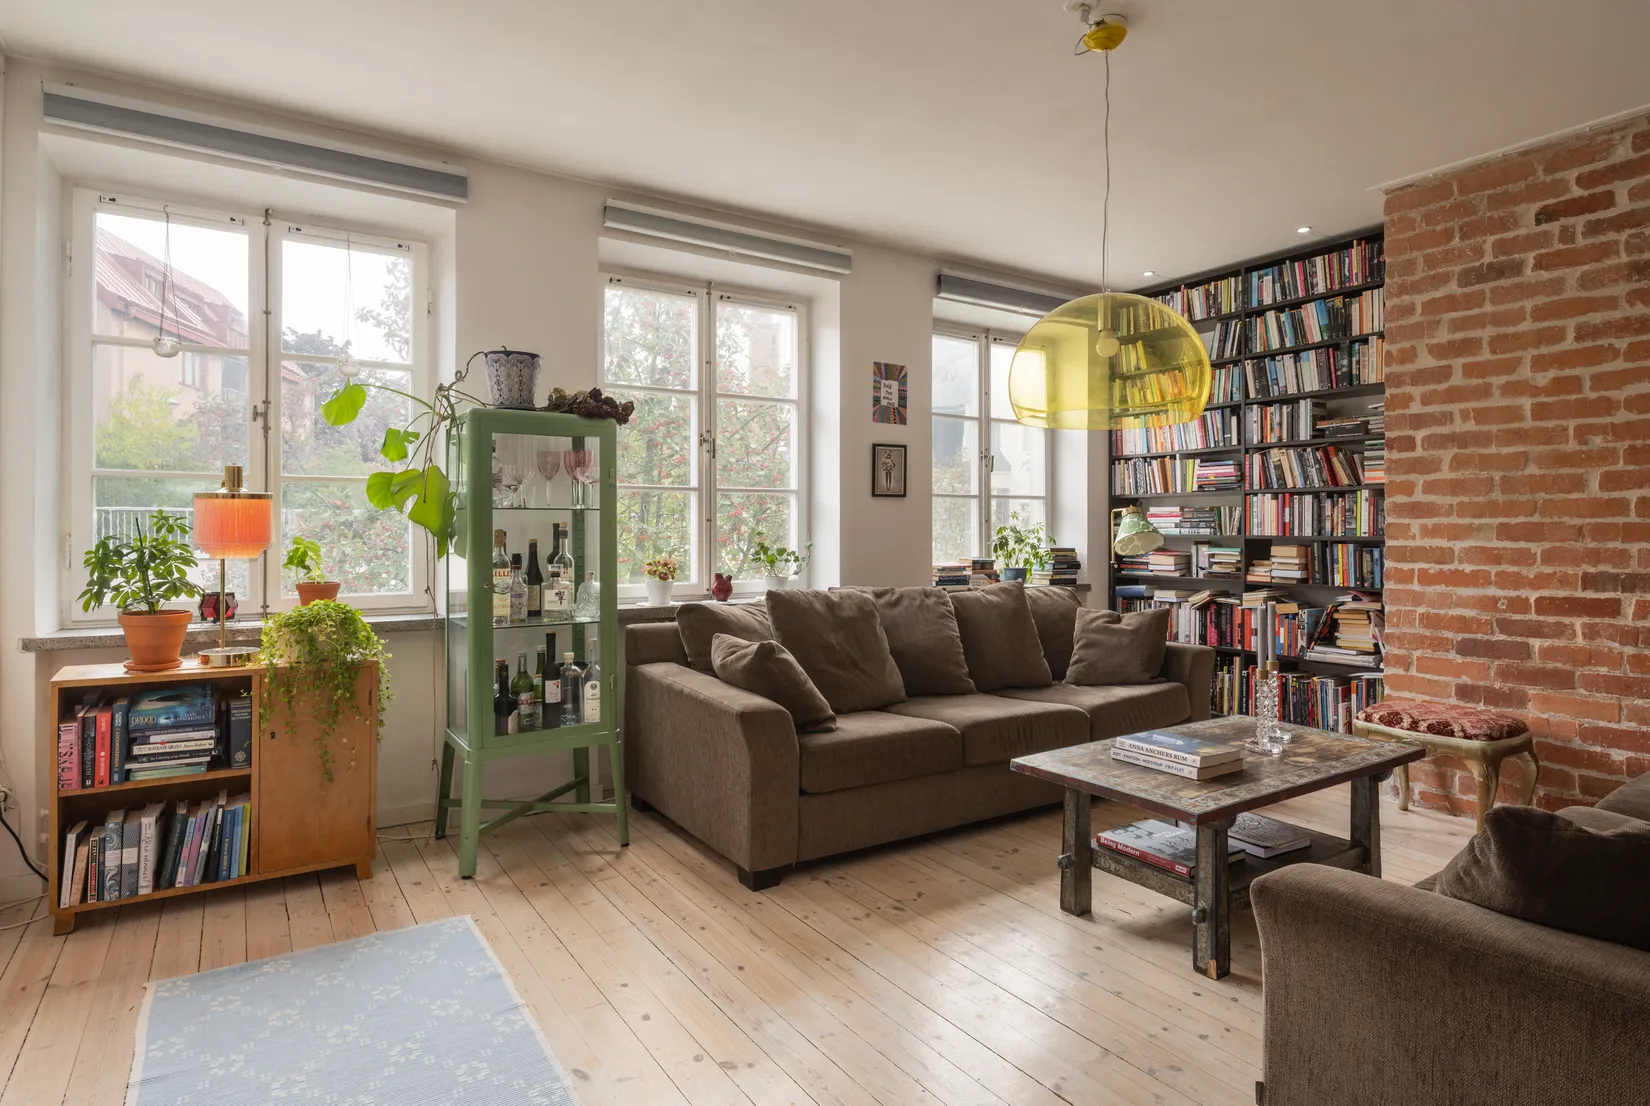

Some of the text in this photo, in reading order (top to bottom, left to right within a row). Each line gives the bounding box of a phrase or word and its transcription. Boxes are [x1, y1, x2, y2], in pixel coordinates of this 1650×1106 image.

[130, 715, 157, 726] DROOD
[1128, 744, 1144, 752] ANNA
[1145, 748, 1172, 758] ANCHERS
[1100, 836, 1140, 856] Being Modern
